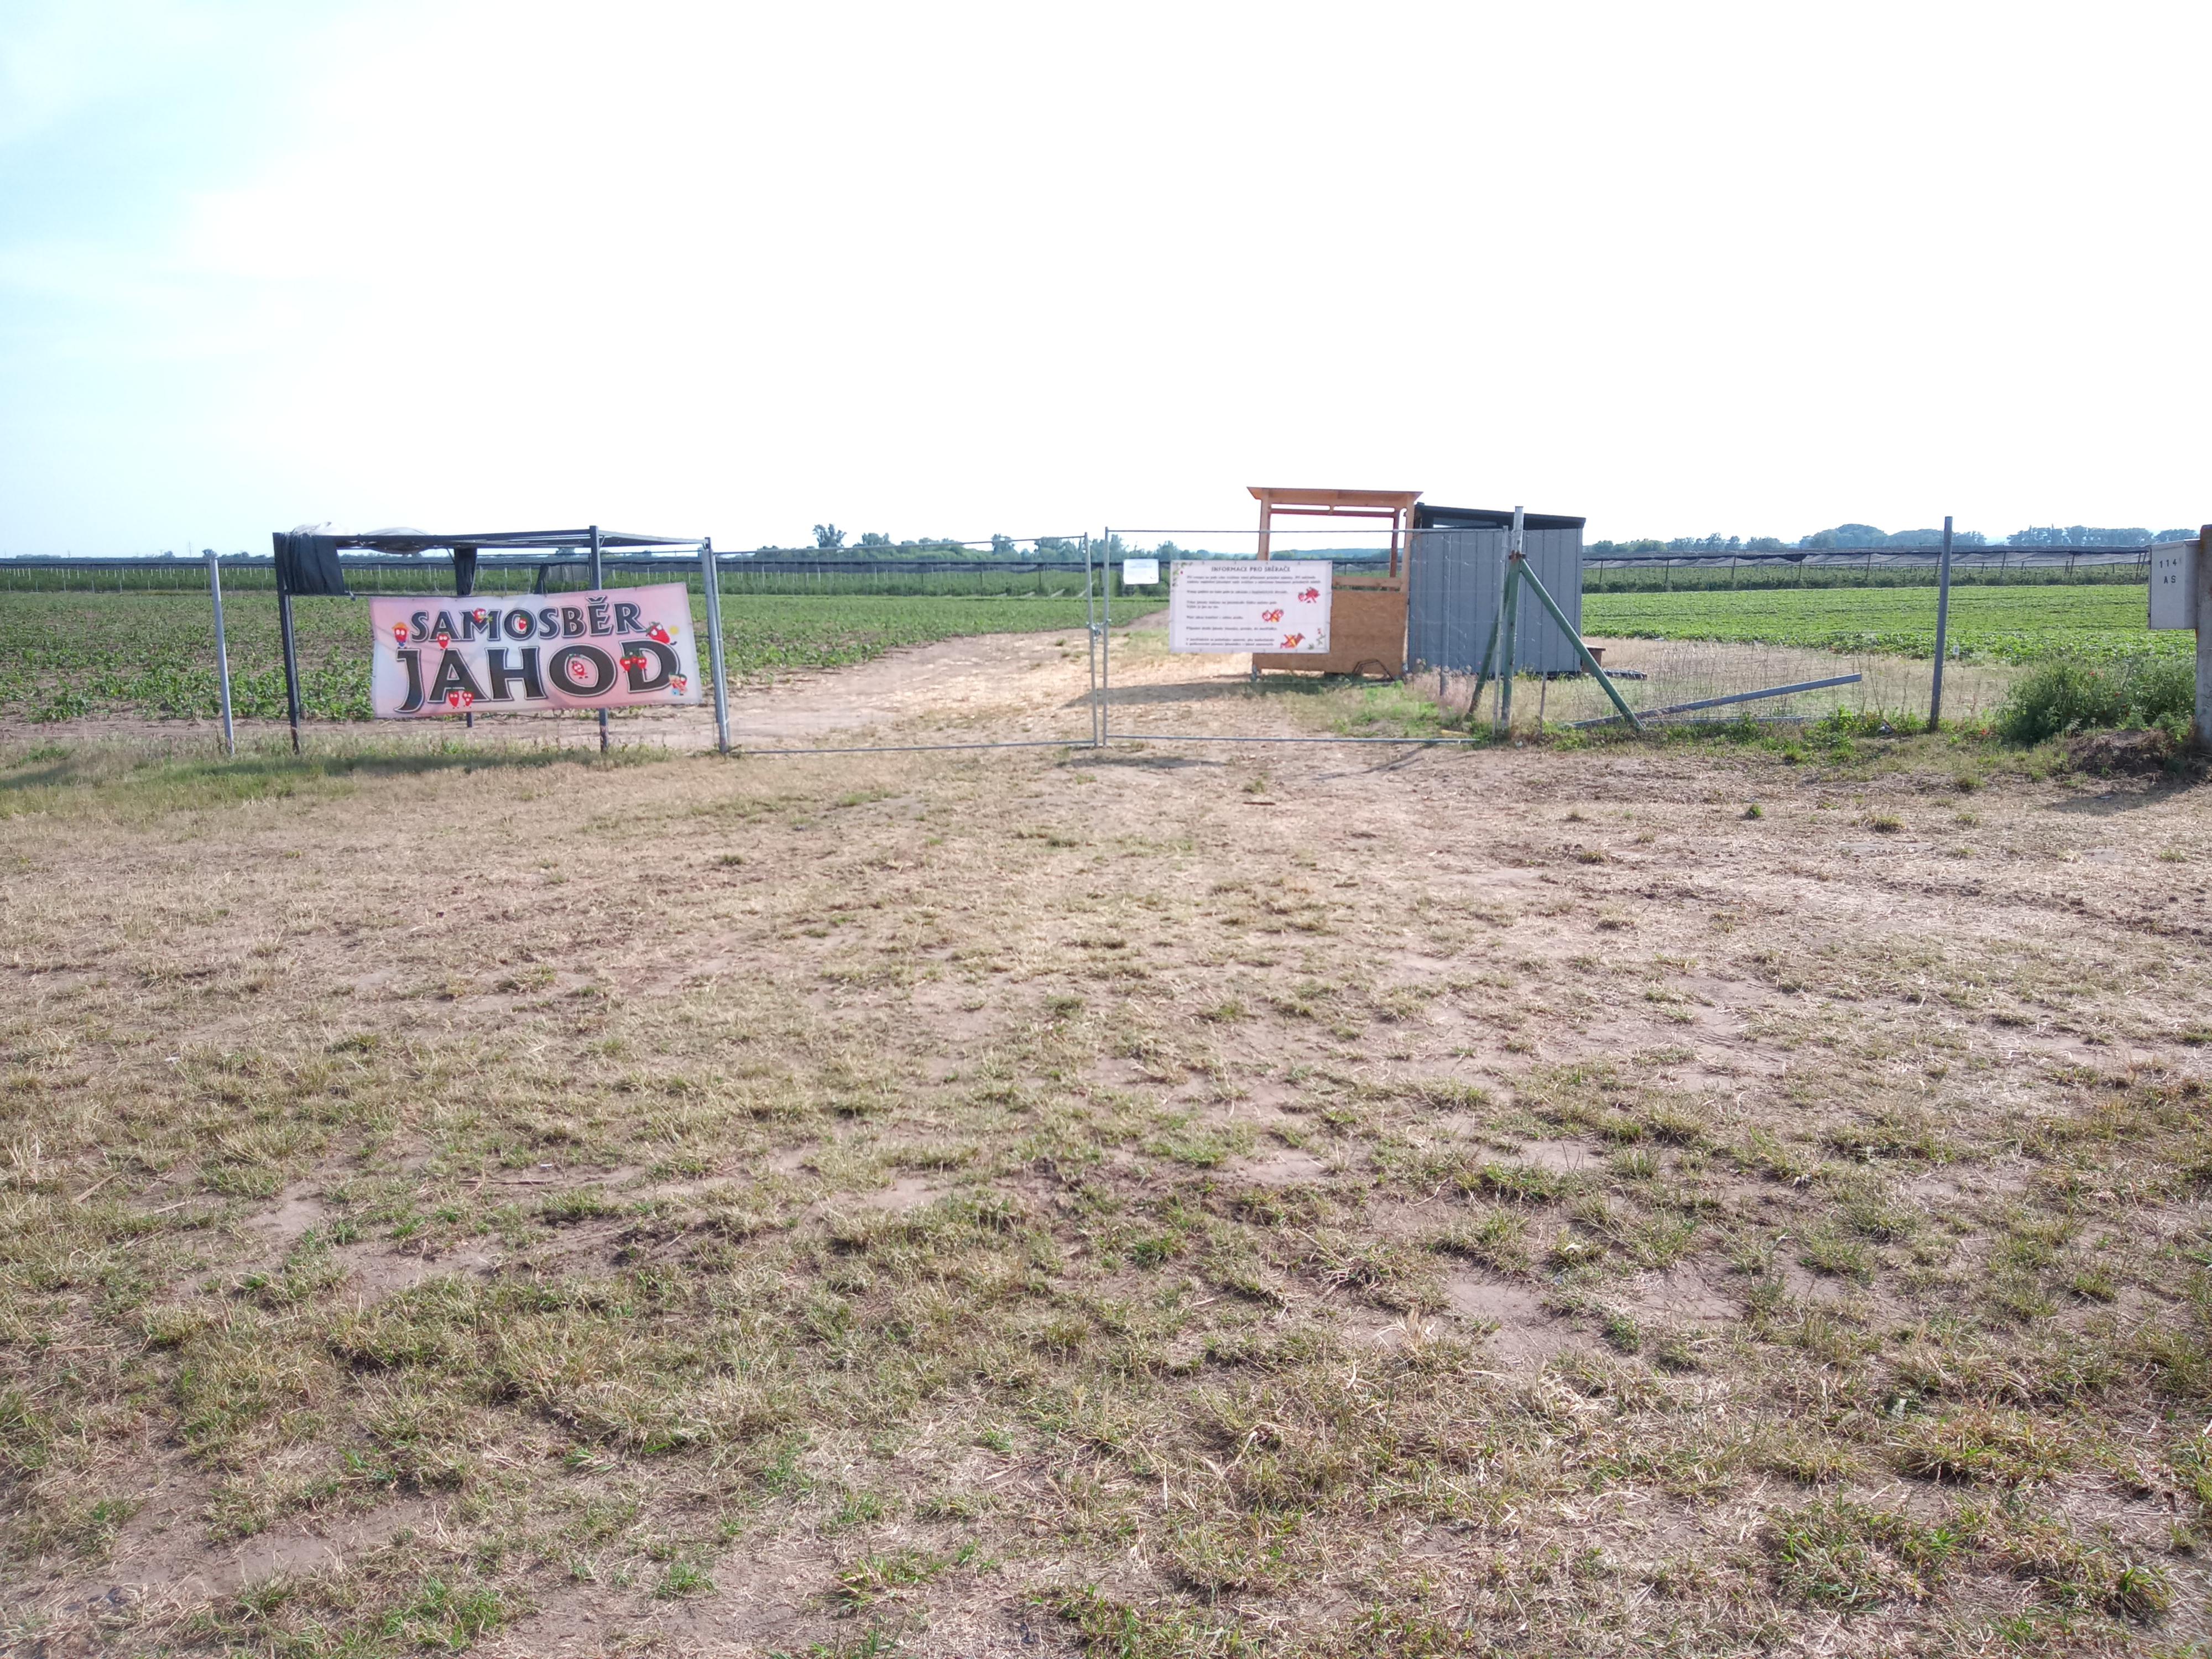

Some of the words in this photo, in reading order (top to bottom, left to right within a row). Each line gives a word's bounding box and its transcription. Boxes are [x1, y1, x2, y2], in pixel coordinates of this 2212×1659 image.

[2163, 575, 2176, 584] AS
[410, 596, 647, 642] SAMOSBĚR
[394, 639, 680, 713] JAHOD
